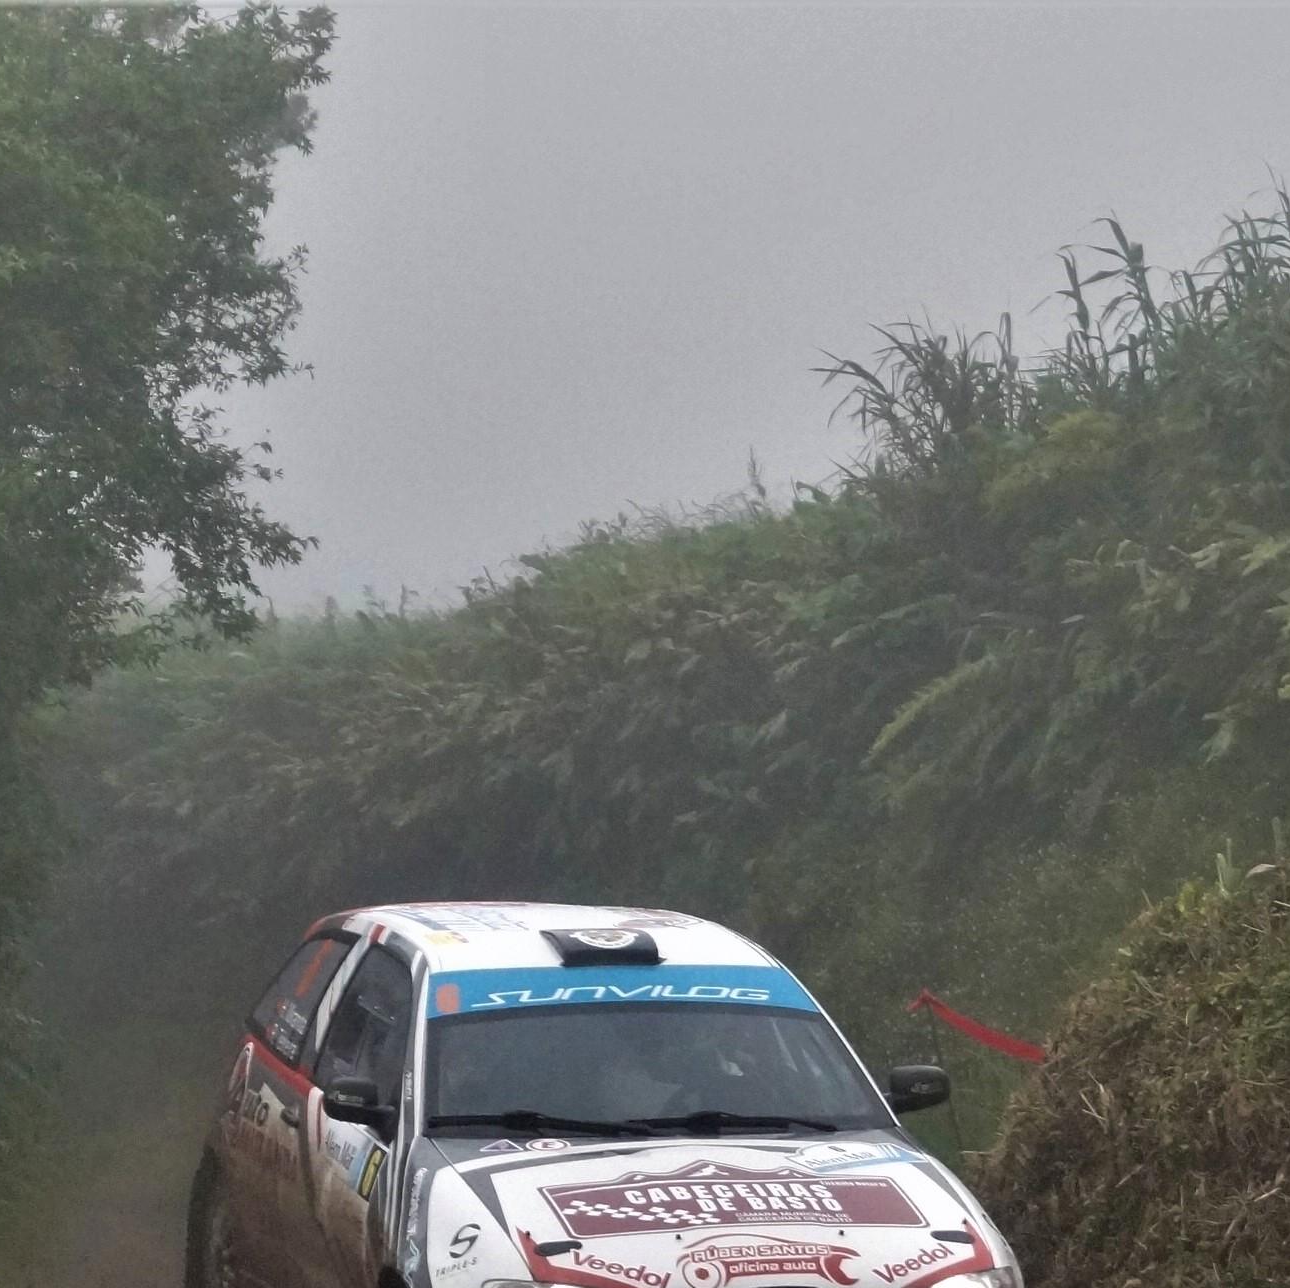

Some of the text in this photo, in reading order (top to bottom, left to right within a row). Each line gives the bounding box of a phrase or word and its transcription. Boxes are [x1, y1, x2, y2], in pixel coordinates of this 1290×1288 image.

[624, 1183, 834, 1205] CABECEIRAS
[696, 1196, 843, 1213] DE BASTO
[759, 1244, 830, 1257] SANTOS
[729, 1260, 817, 1274] oficina auto
[872, 1243, 955, 1284] Veedol
